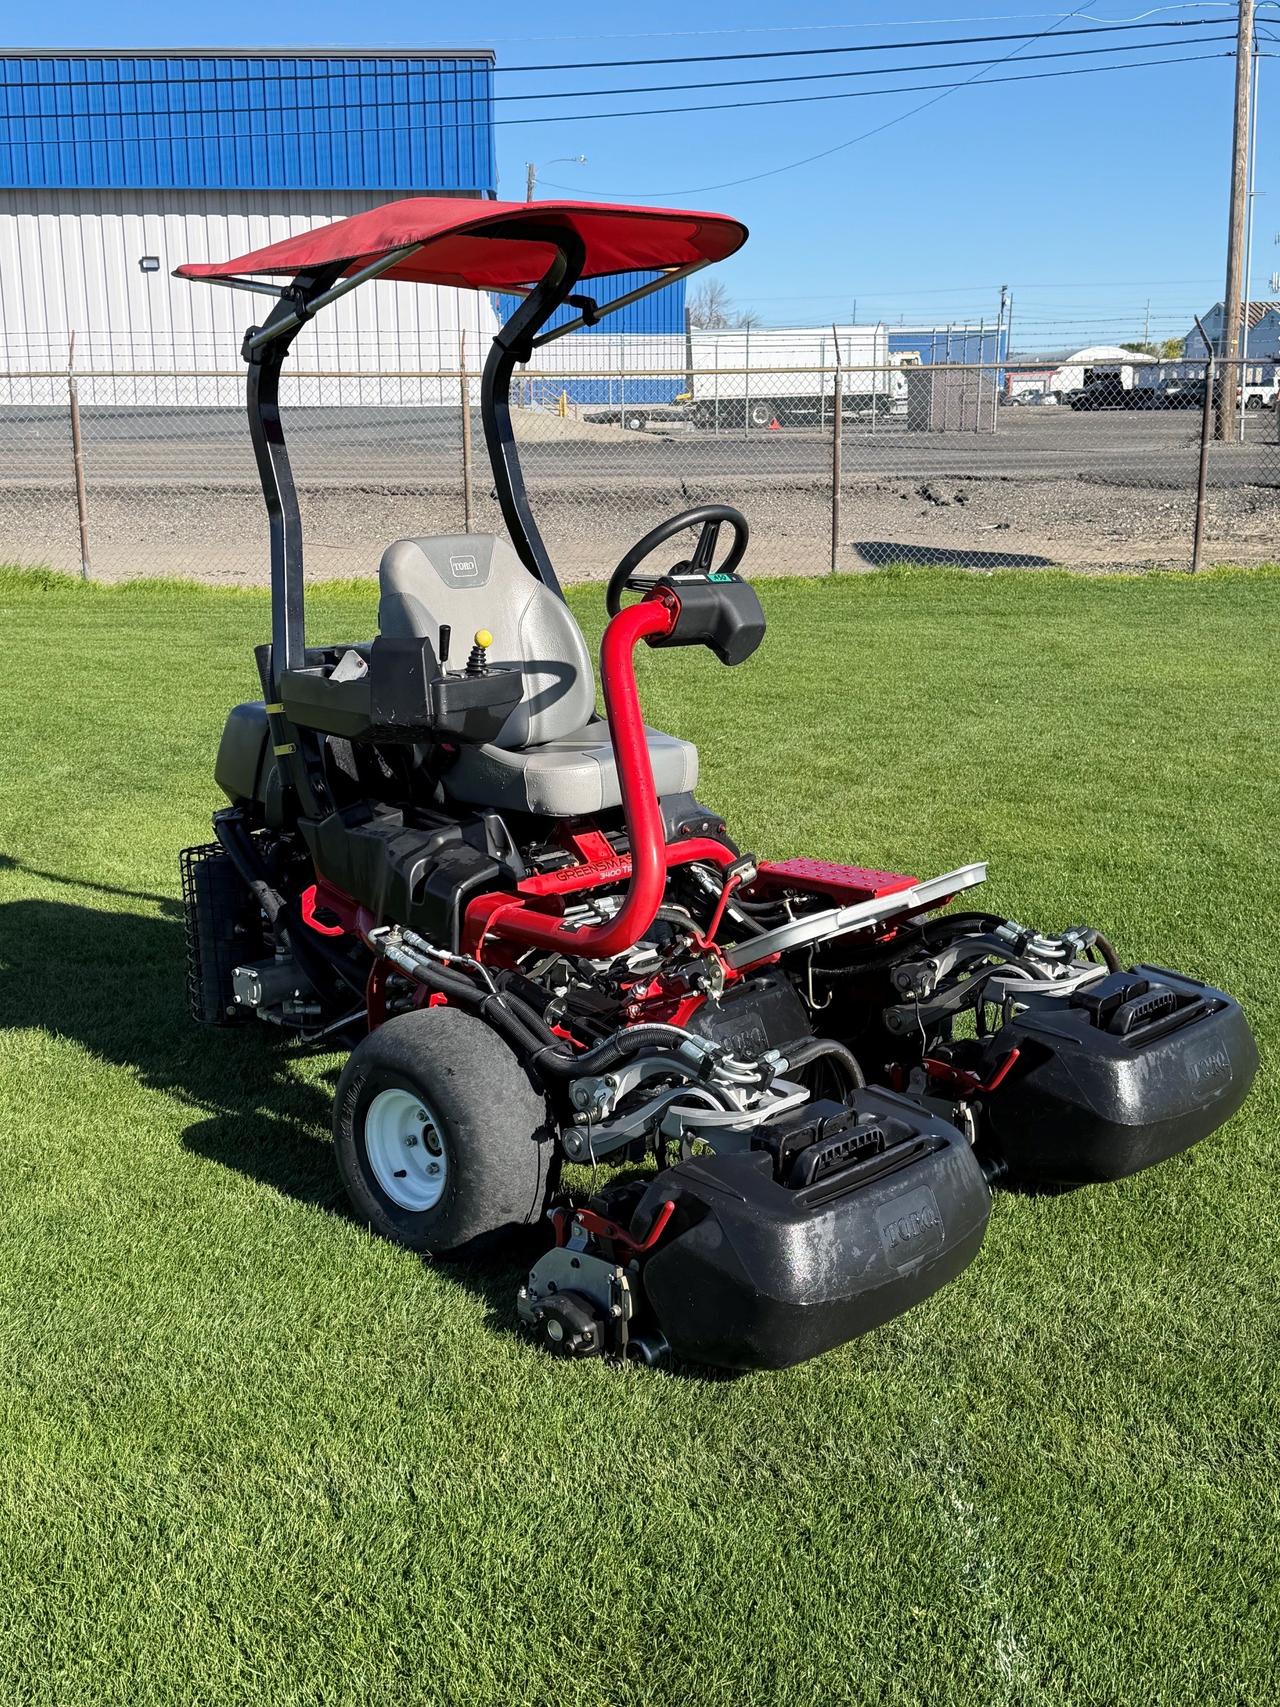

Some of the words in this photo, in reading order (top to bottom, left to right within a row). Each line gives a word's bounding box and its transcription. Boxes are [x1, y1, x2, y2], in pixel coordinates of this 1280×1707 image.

[453, 562, 475, 571] TORO
[600, 869, 621, 880] 3400
[882, 1204, 939, 1248] TORO
